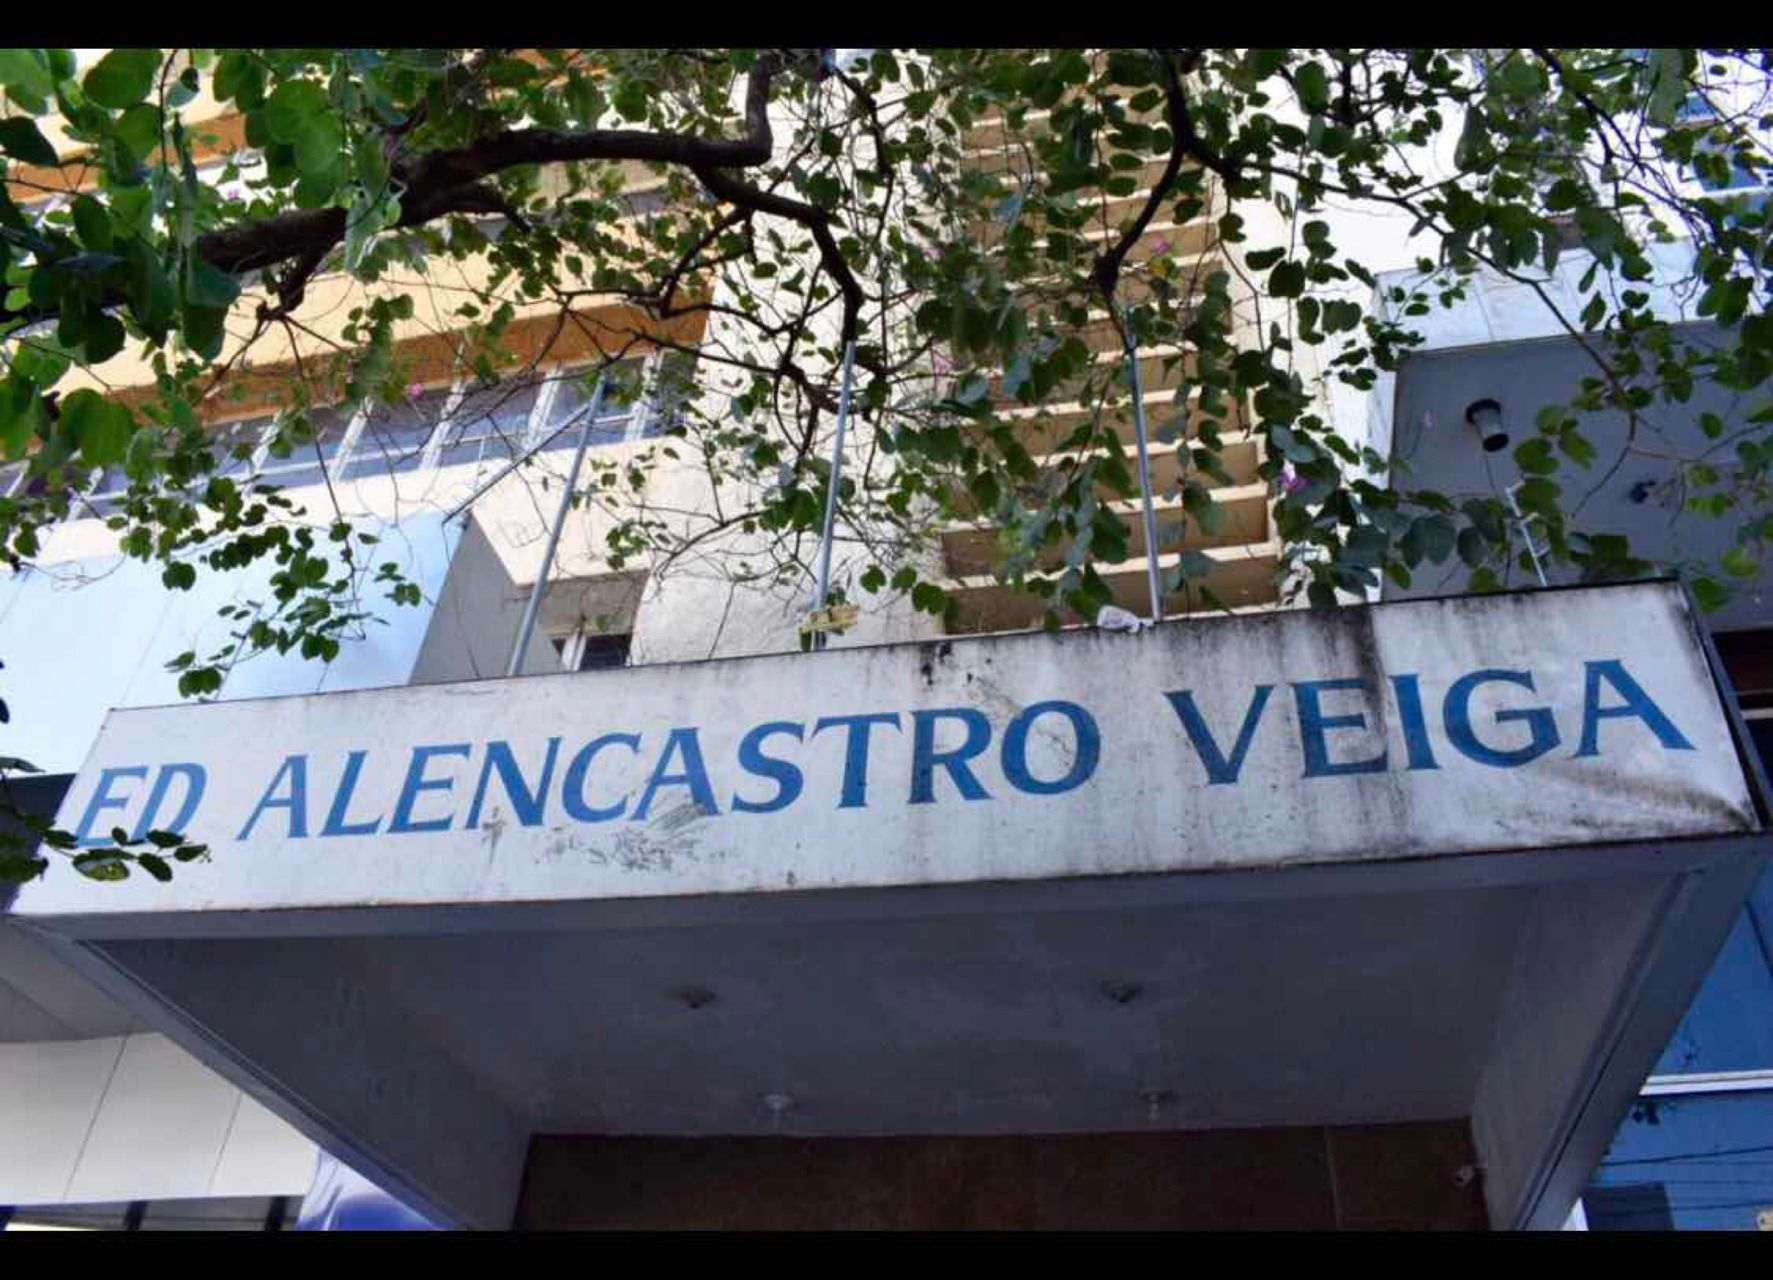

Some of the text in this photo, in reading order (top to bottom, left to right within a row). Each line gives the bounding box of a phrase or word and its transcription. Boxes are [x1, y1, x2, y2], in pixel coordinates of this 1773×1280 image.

[74, 659, 1695, 847] ED ALENCASTRO VEIGA
